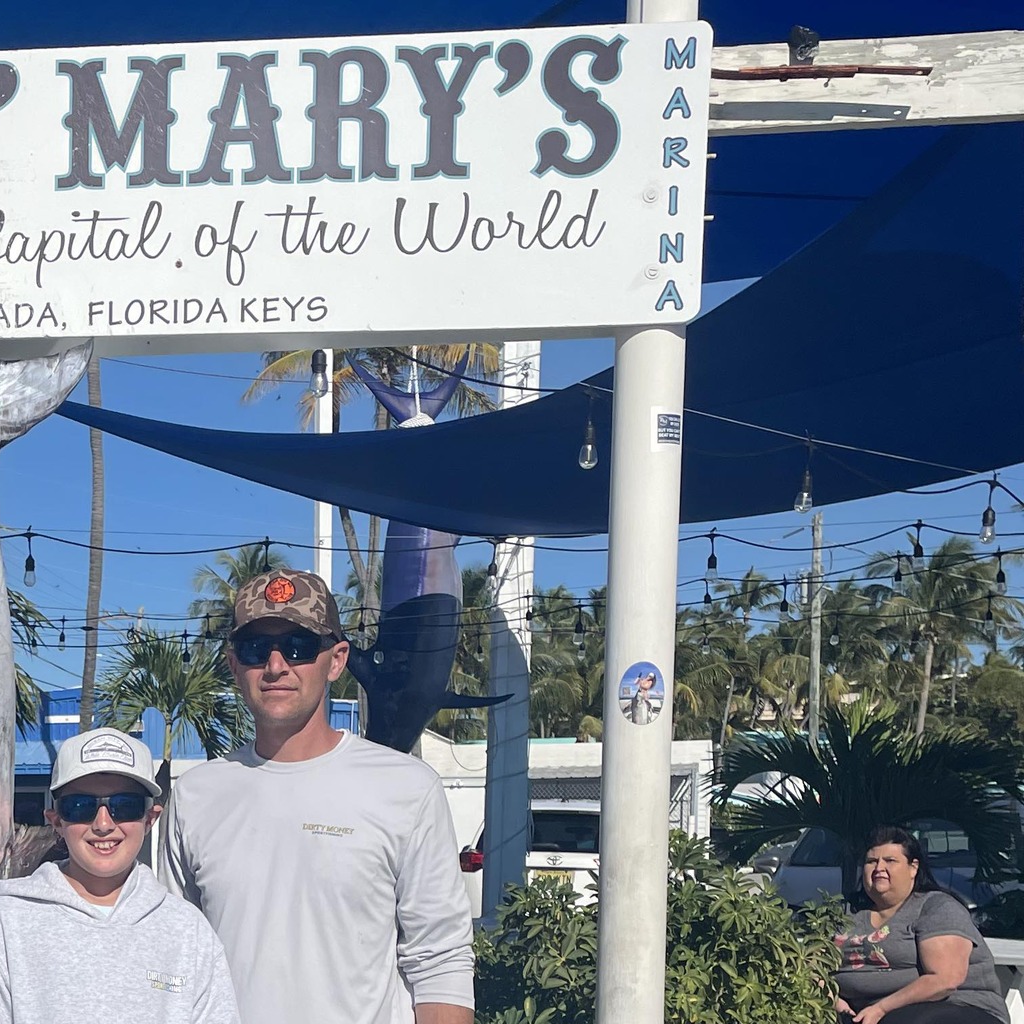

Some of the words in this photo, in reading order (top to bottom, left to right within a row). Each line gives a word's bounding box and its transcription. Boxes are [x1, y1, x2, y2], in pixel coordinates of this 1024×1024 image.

[54, 34, 629, 191] MARY'S
[654, 36, 704, 313] MARINA
[193, 200, 259, 286] of
[264, 196, 370, 256] the
[392, 188, 606, 256] World
[87, 297, 228, 327] FLORIDA
[239, 296, 329, 324] KEYS
